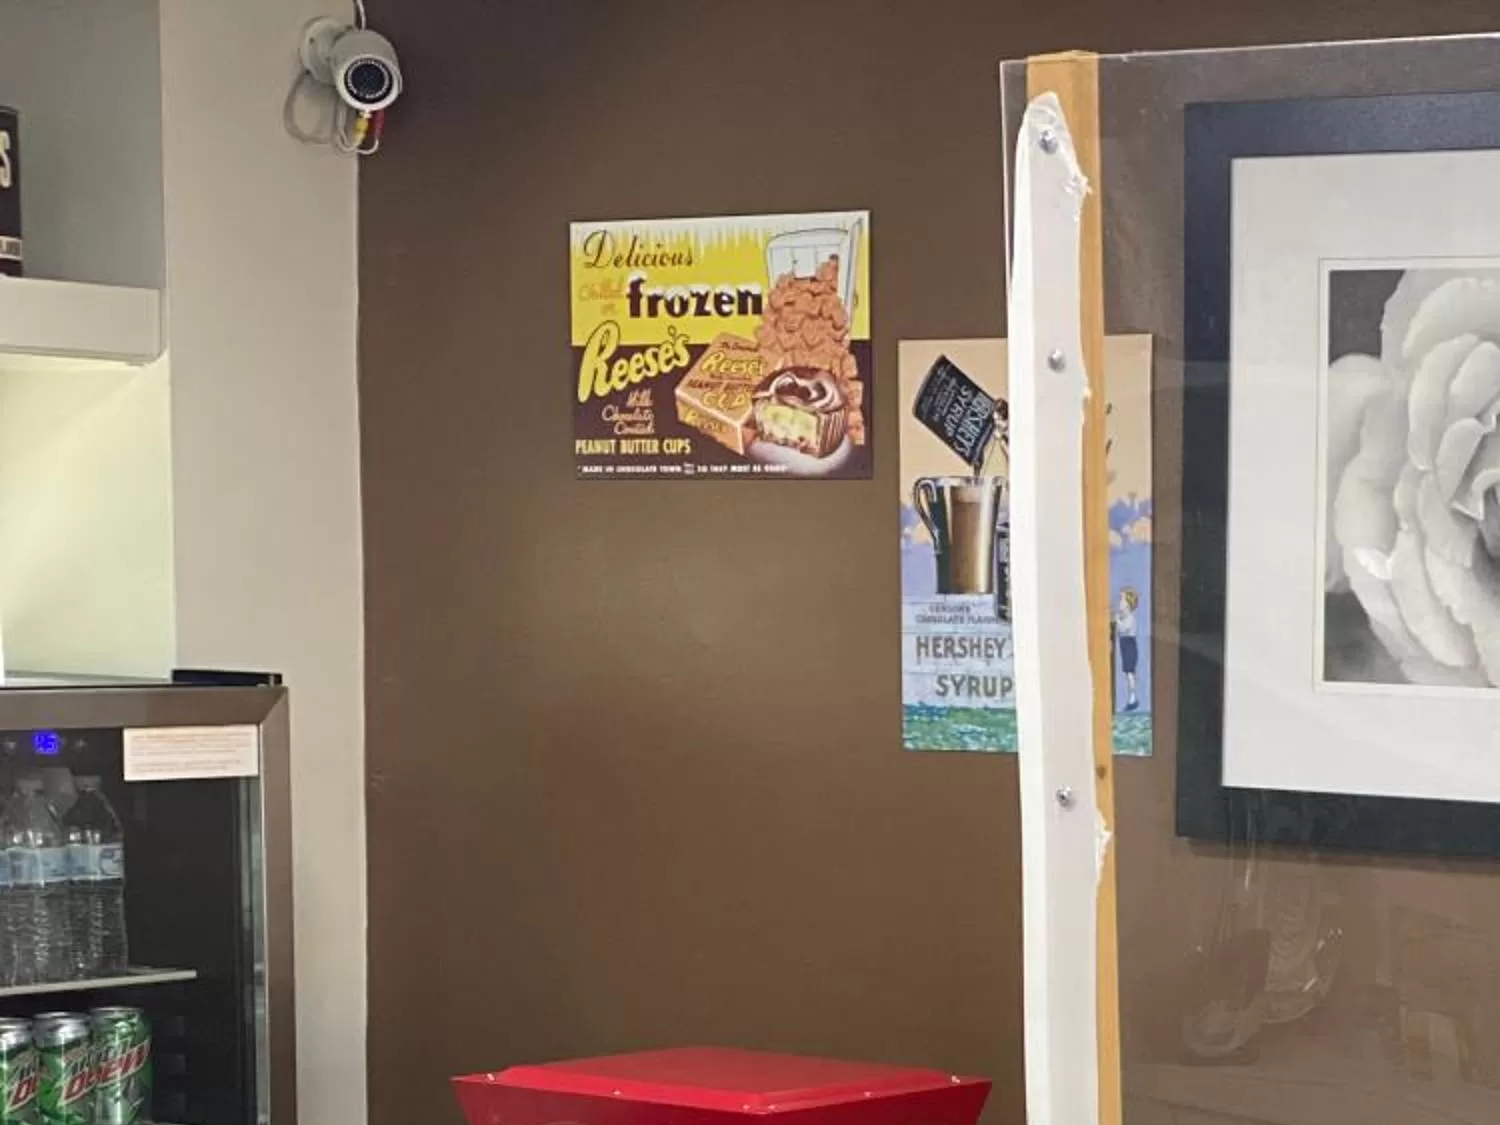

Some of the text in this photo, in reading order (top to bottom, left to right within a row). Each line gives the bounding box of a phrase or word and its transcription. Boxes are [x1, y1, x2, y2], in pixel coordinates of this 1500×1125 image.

[583, 229, 694, 269] Delicious
[626, 271, 763, 318] frozen
[577, 319, 691, 403] Reese's
[575, 438, 692, 454] PEANUT BUTTER CUPS
[936, 674, 1013, 697] SYRUP
